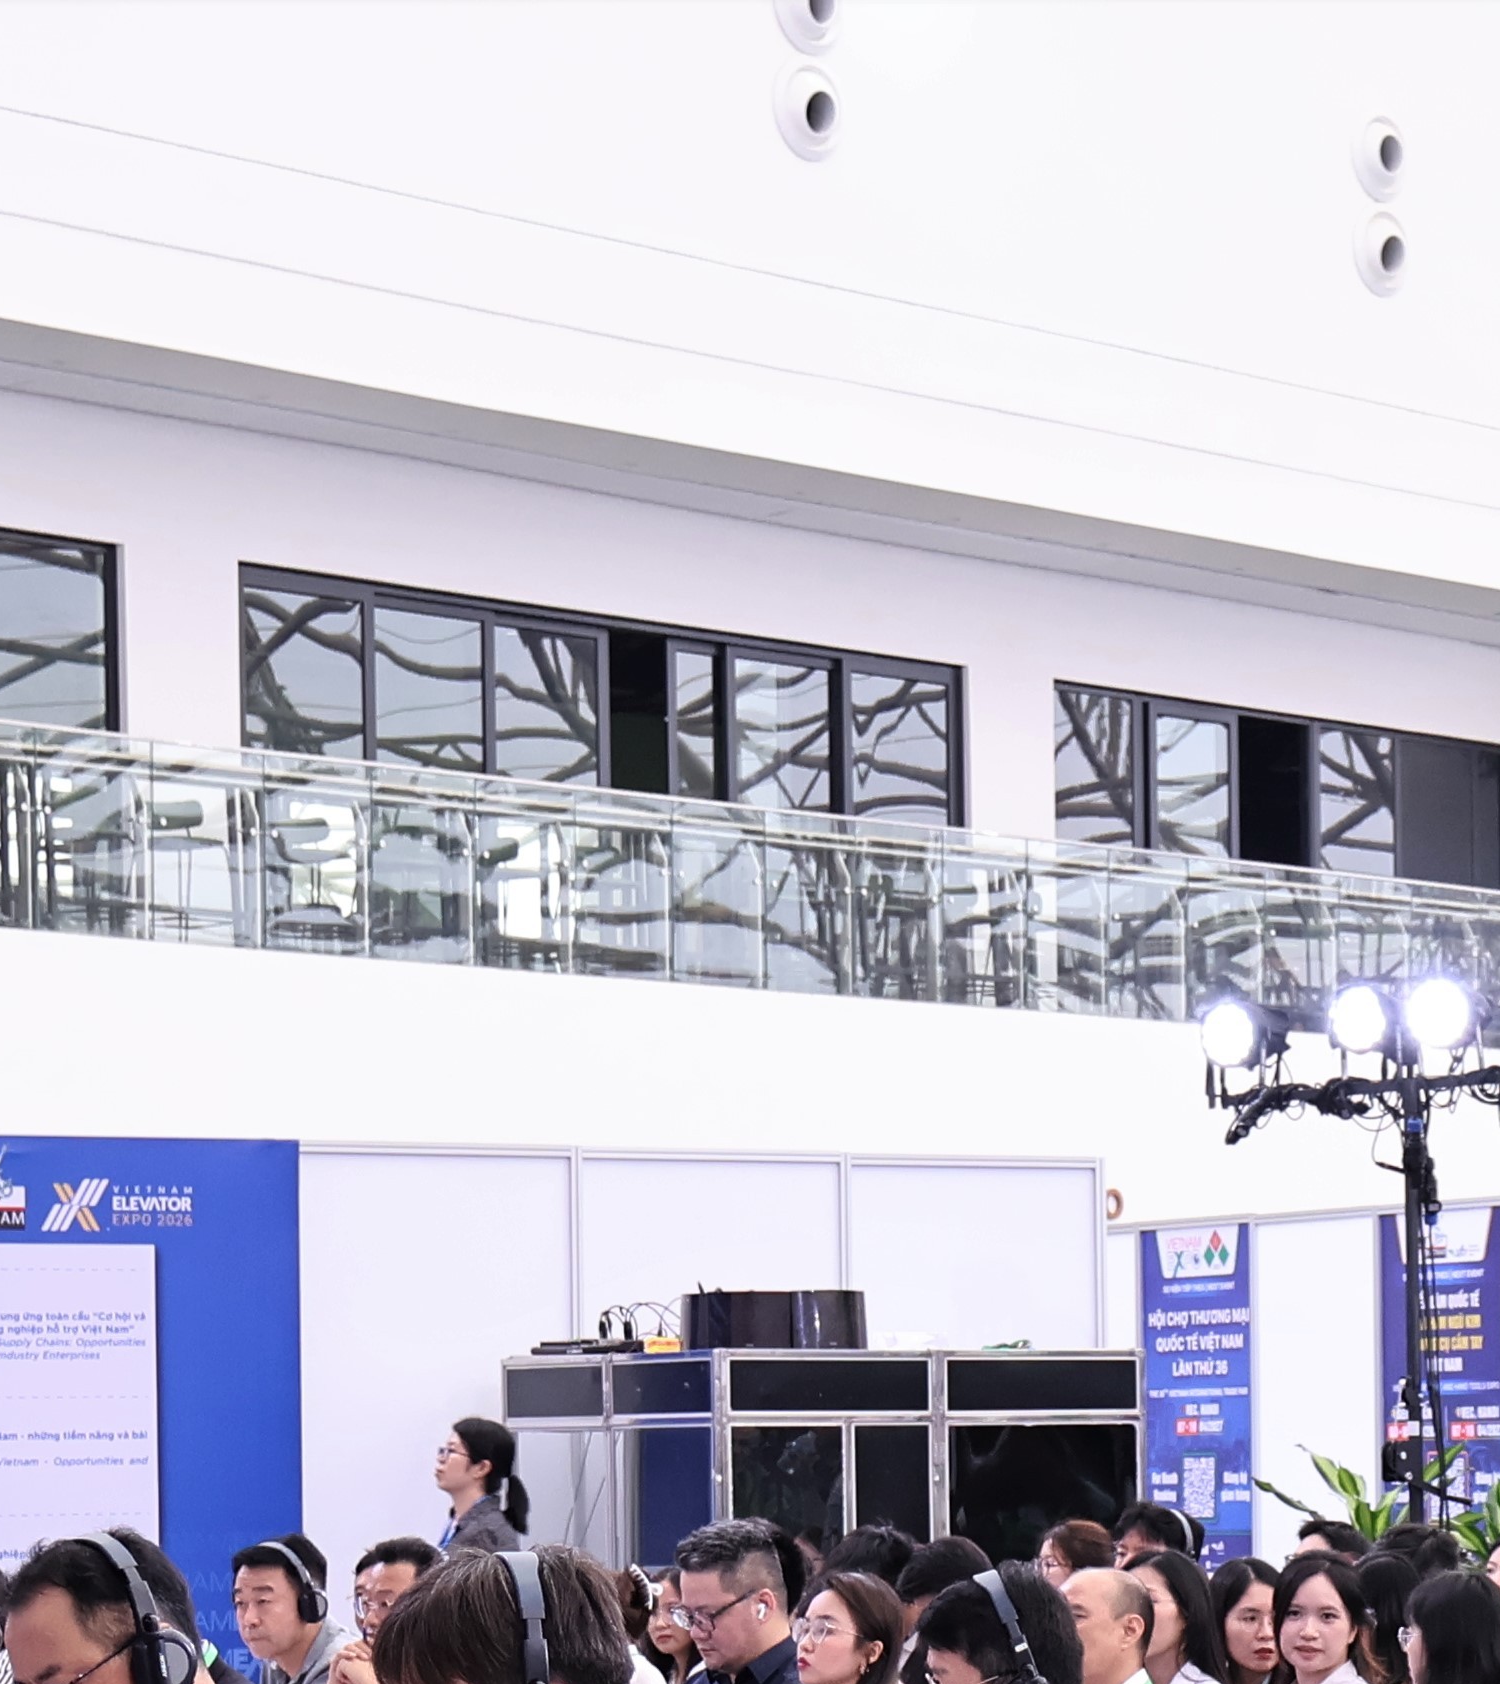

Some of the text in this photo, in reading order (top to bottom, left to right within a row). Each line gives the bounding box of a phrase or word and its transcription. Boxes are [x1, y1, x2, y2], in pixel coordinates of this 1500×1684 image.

[113, 1185, 193, 1195] VIETNAM
[112, 1196, 192, 1212] ELEVATOR
[112, 1214, 193, 1227] EXPO 2026
